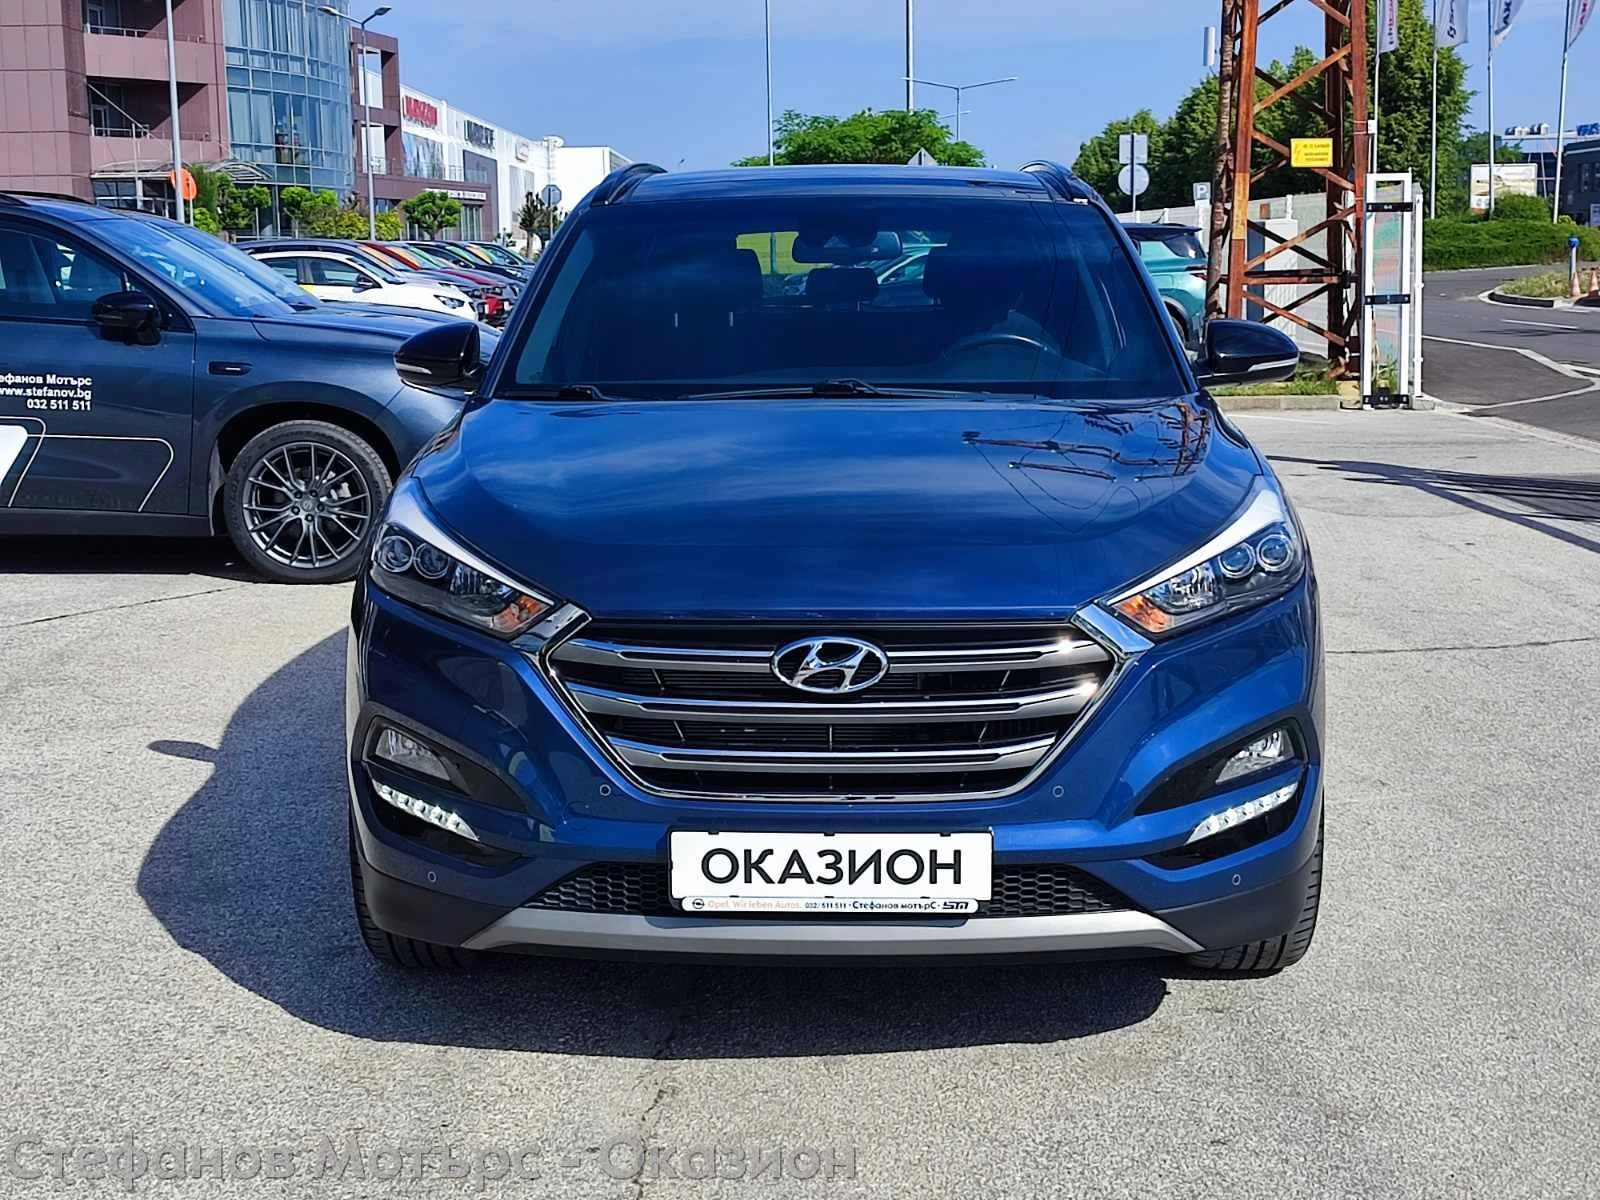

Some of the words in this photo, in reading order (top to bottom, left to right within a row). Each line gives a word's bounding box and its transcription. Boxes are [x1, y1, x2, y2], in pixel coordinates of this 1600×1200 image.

[46, 374, 92, 387] Мотърс
[0, 387, 92, 400] www.stefanov.bg
[27, 399, 48, 410] 032
[50, 400, 69, 410] 511
[72, 401, 91, 411] 511
[701, 848, 962, 885] ОКАЗИОН
